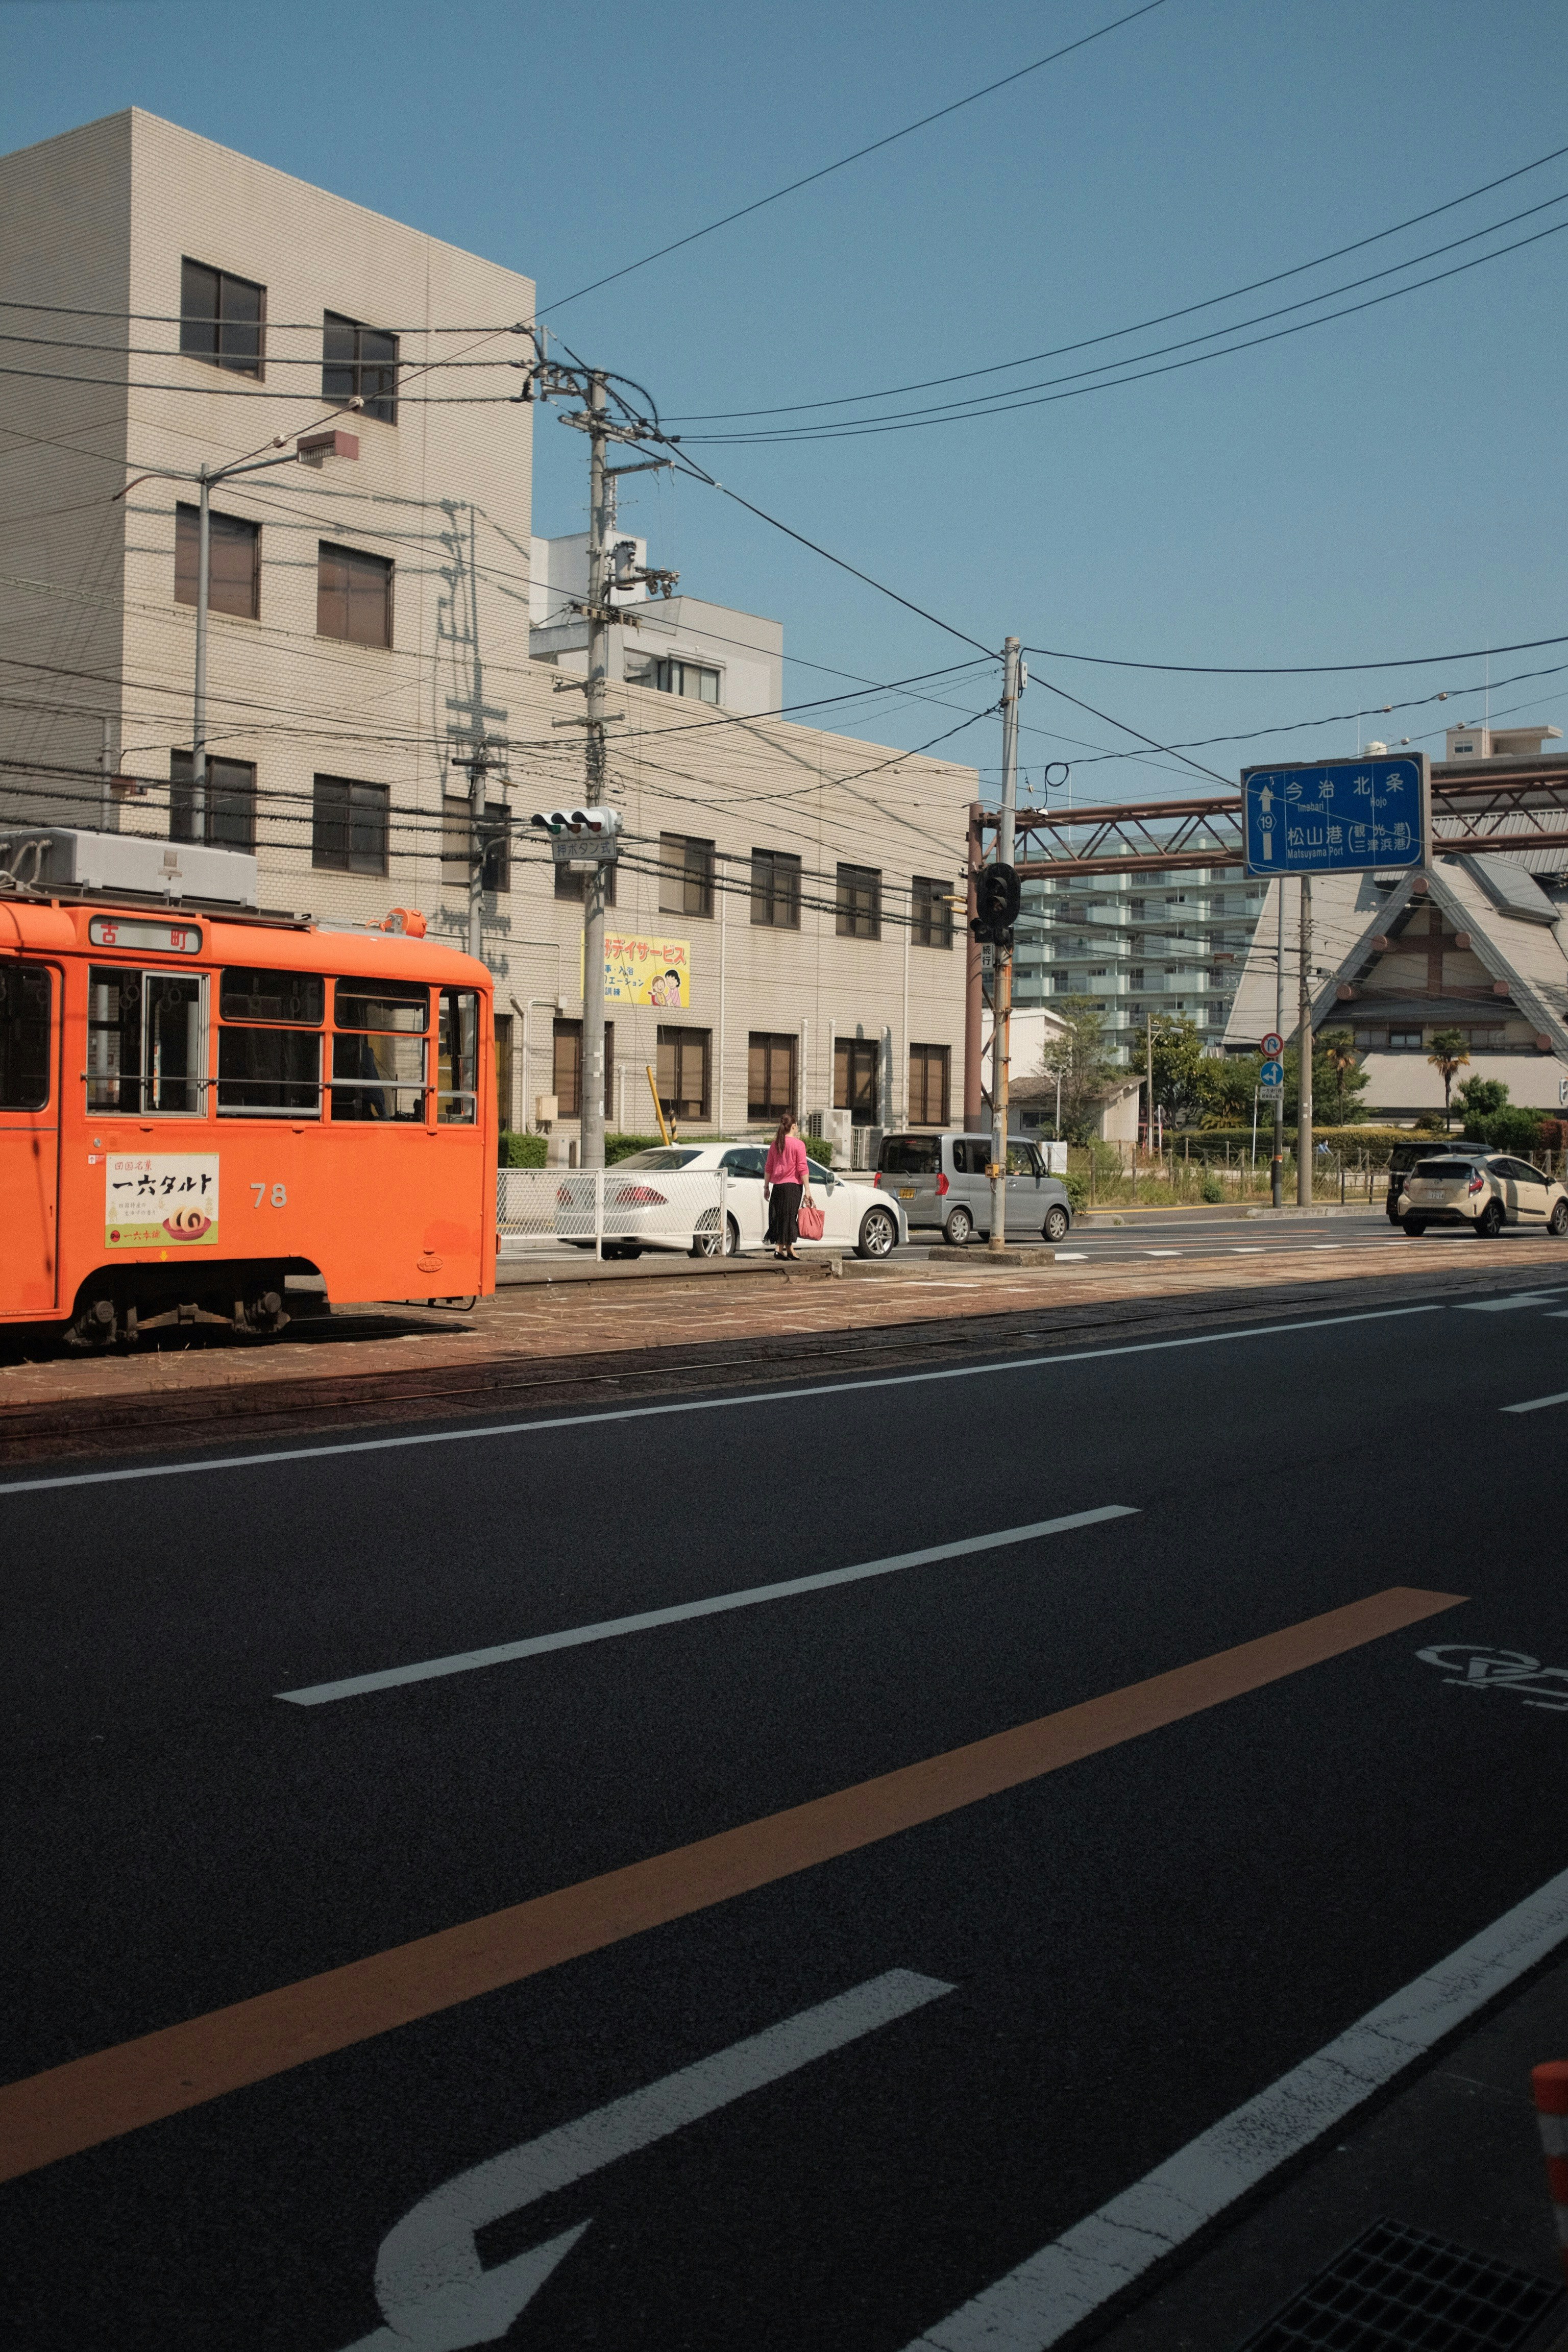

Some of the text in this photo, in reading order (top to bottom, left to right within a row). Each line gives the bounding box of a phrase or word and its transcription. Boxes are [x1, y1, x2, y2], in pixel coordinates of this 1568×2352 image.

[1286, 780, 1334, 801] 今治
[1353, 773, 1404, 795] 北条
[1297, 801, 1324, 813] Imabari
[1370, 796, 1387, 808] Hojo
[1260, 816, 1272, 829] 19
[1288, 825, 1342, 846] 松山港
[557, 841, 610, 856] 押ボタン式
[1287, 846, 1343, 860] Matsuyama Port
[100, 921, 188, 950] 古町
[115, 1159, 152, 1171] 四国名菓
[112, 1173, 212, 1196] 一六タルト
[250, 1183, 287, 1209] 78
